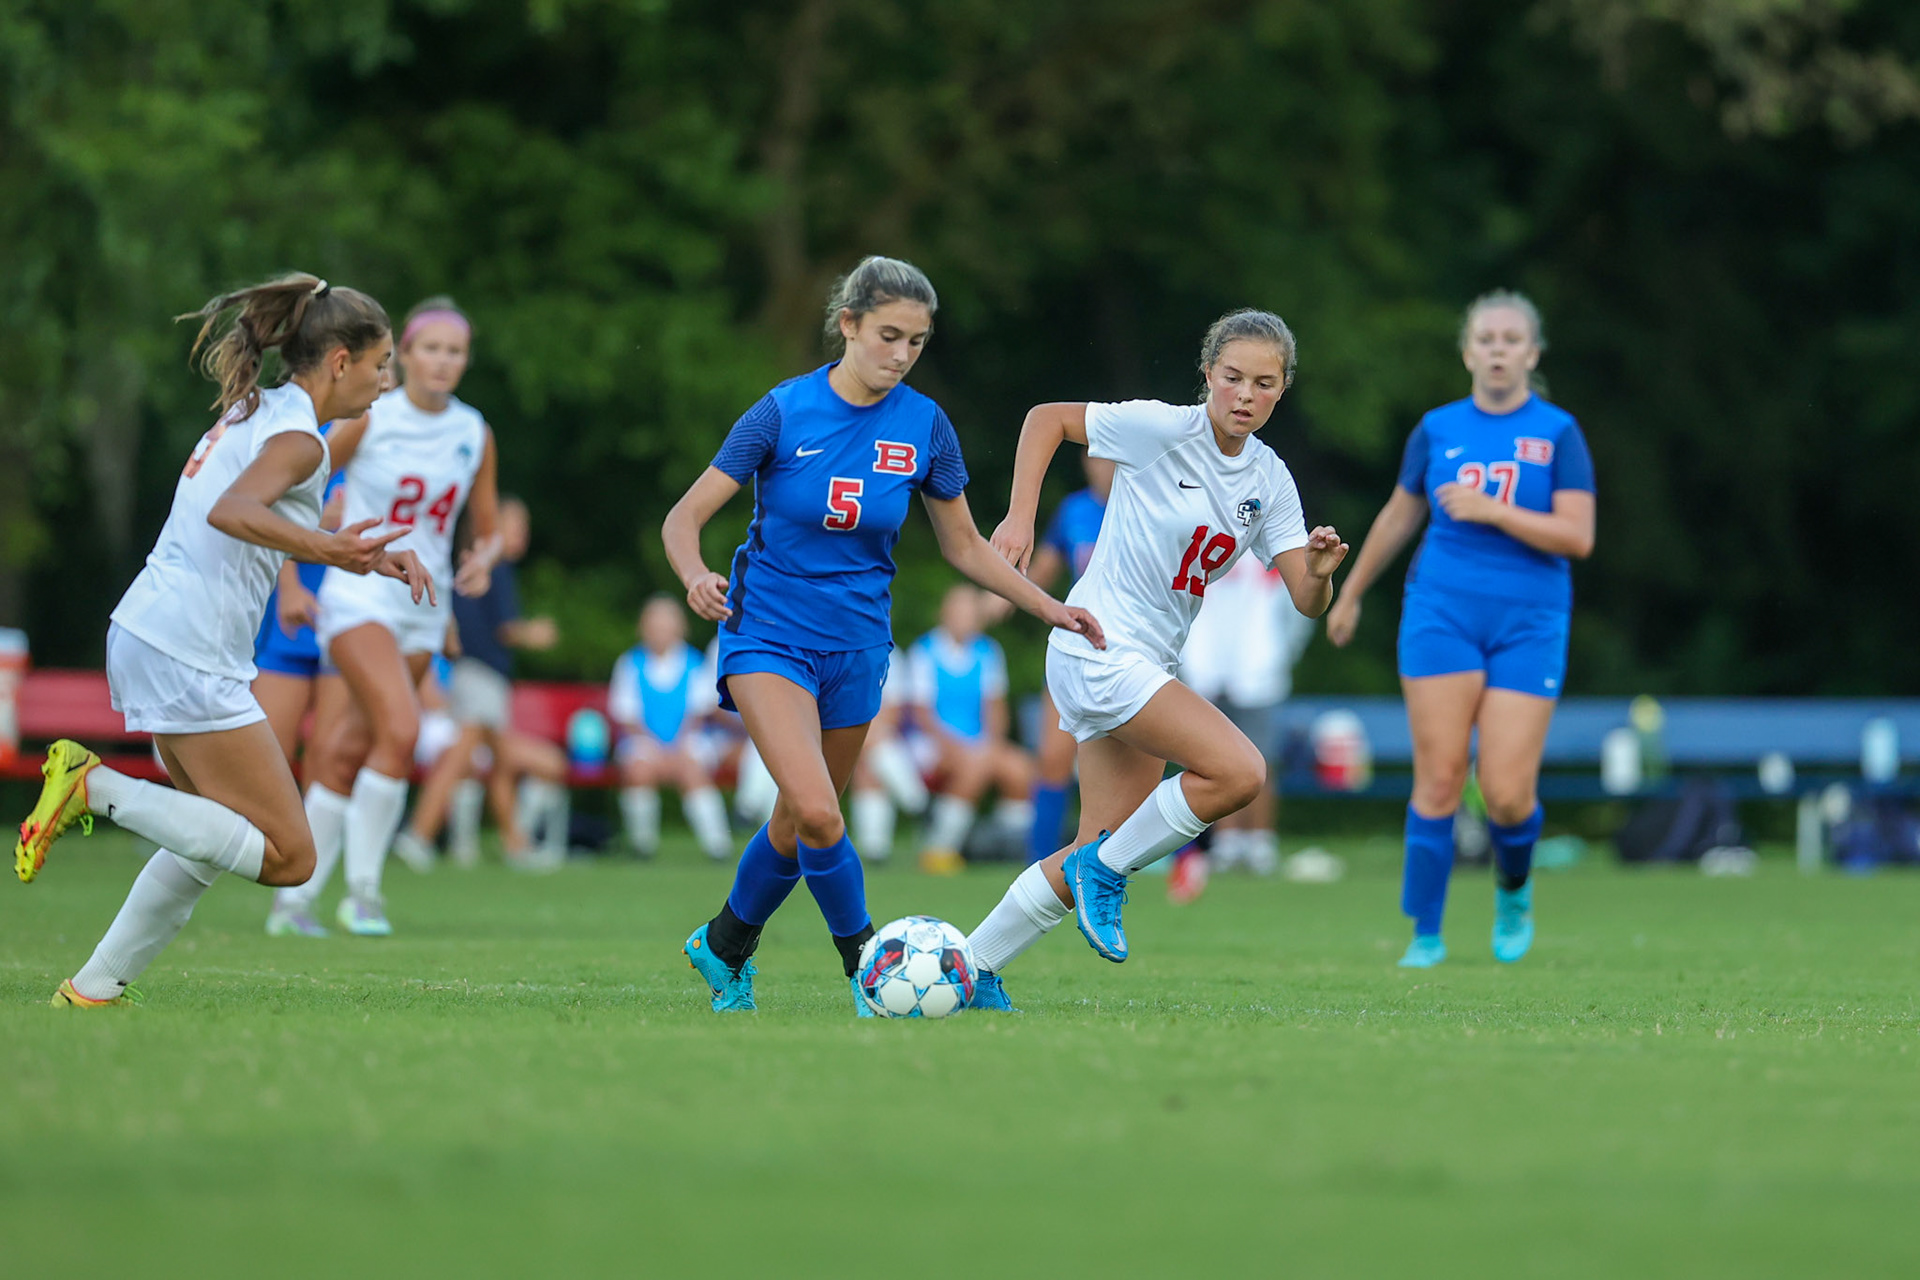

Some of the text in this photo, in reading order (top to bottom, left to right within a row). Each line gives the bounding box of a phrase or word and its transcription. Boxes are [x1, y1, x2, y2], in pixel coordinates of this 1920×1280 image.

[872, 439, 917, 476] B
[1457, 461, 1520, 507] 27
[390, 475, 457, 534] 24
[822, 476, 864, 531] 5
[1171, 525, 1237, 598] 19
